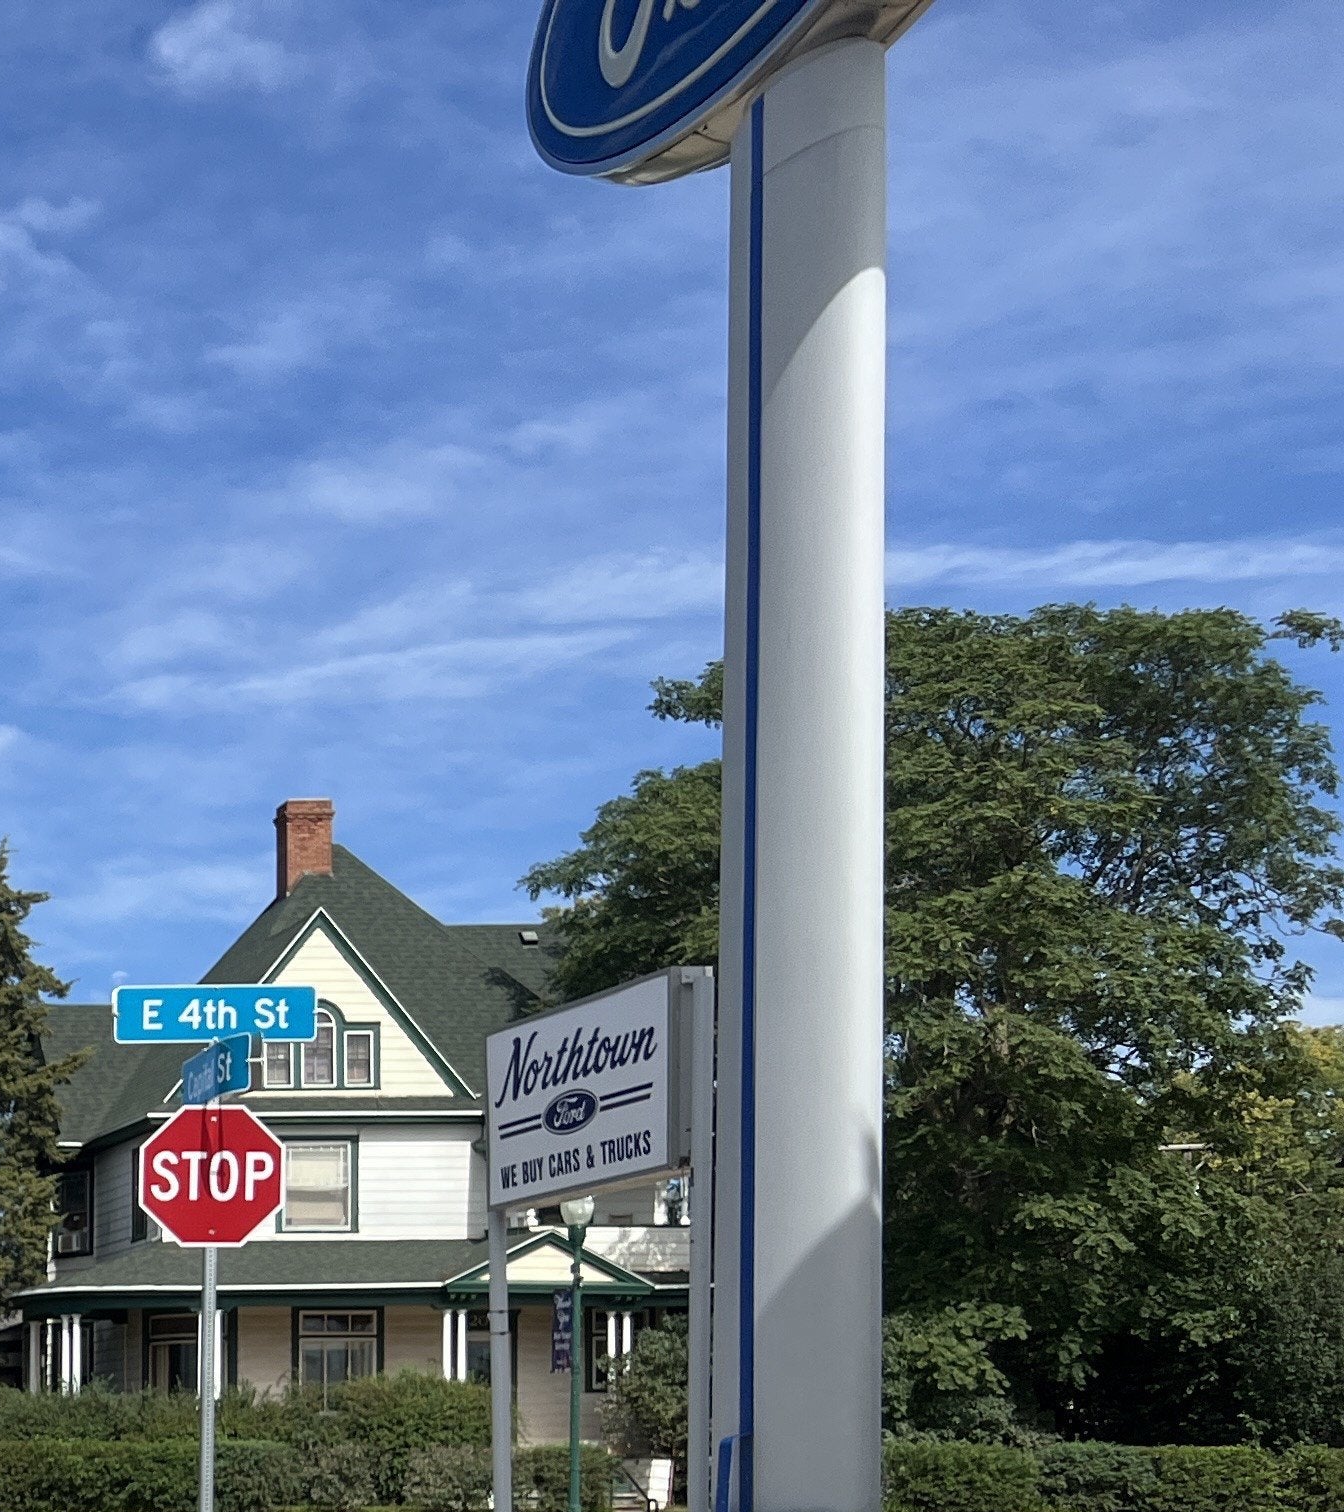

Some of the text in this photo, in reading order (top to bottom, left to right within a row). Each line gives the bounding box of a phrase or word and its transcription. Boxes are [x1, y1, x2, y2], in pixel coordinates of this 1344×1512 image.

[143, 998, 290, 1030] E 4th St
[217, 1051, 232, 1083] St
[495, 1026, 657, 1108] Northtown
[554, 1096, 587, 1128] Ford
[150, 1150, 274, 1202] STOP
[501, 1130, 652, 1189] WE BUY CARS & TRUCKS
